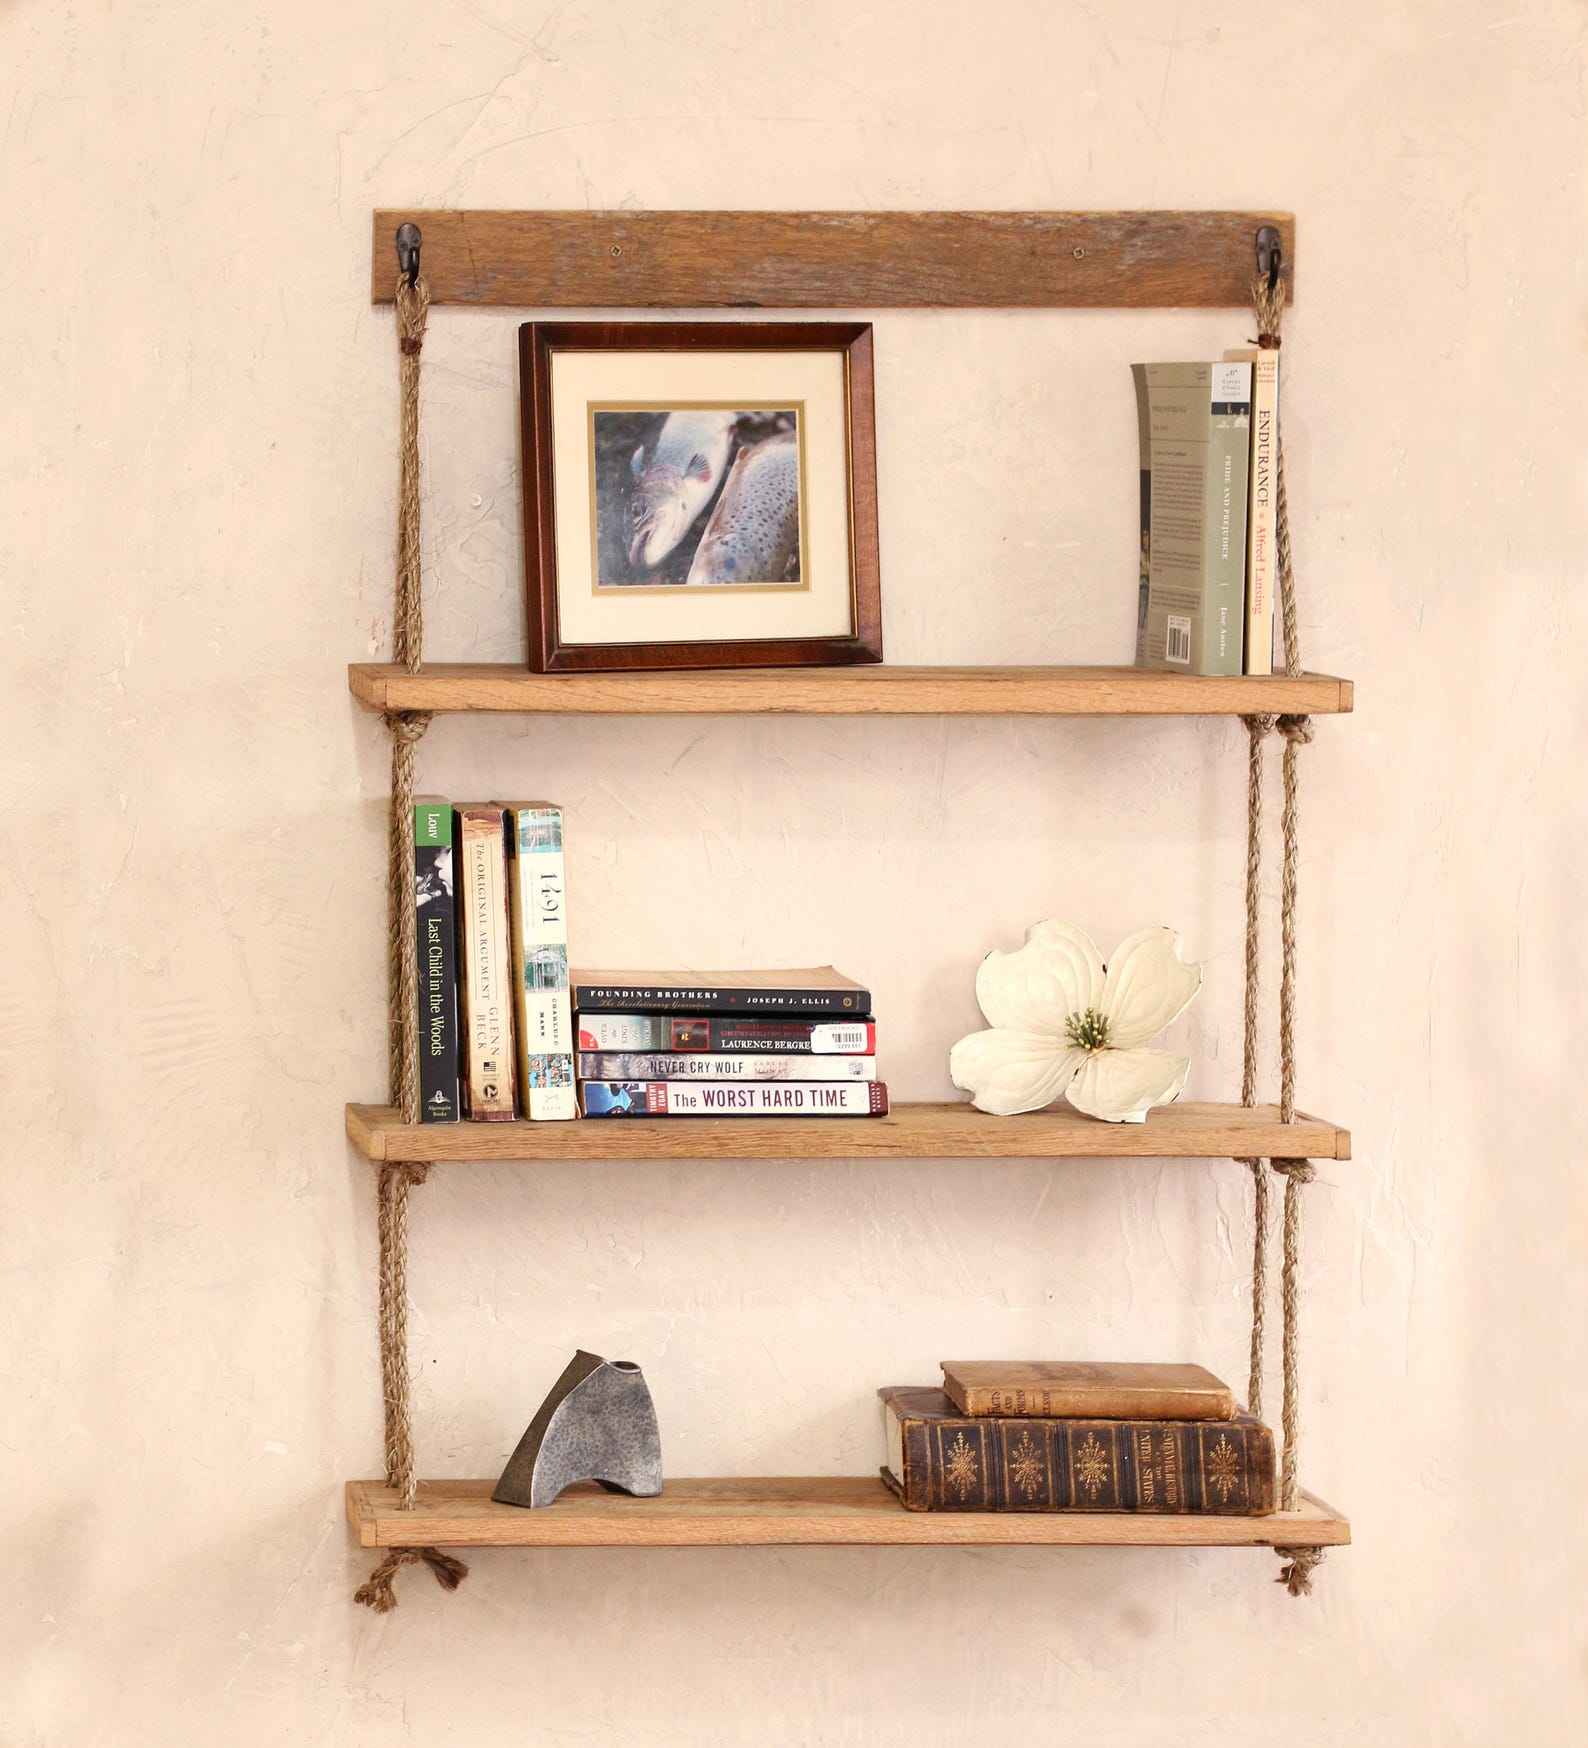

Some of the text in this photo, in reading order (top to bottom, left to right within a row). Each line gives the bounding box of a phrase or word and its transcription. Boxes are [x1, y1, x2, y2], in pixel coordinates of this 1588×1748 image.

[1257, 409, 1270, 508] ENDURANCE
[1221, 455, 1232, 561] PRIDE AND PREJUDICE
[1252, 525, 1267, 615] Alfred Lansing
[1219, 606, 1228, 657] Jane Austen
[428, 813, 440, 839] Louv
[538, 873, 562, 924] 1491
[476, 842, 490, 1000] The ORIGINAL ARGUMENT
[428, 917, 445, 1056] Last Child in the Woods
[590, 990, 718, 999] FOUNDING BROTHERS
[476, 1014, 487, 1049] BECK
[488, 1006, 500, 1056] GLENN
[551, 998, 560, 1039] CHARLES
[721, 1040, 811, 1050] LAURENCE BERGRE
[650, 1061, 744, 1073] NEVER CRY WOLF
[648, 1084, 658, 1112] TIMOTHY
[658, 1090, 666, 1107] EGAN
[673, 1089, 848, 1107] The WORST HARD TIME
[1142, 1468, 1155, 1503] STATES
